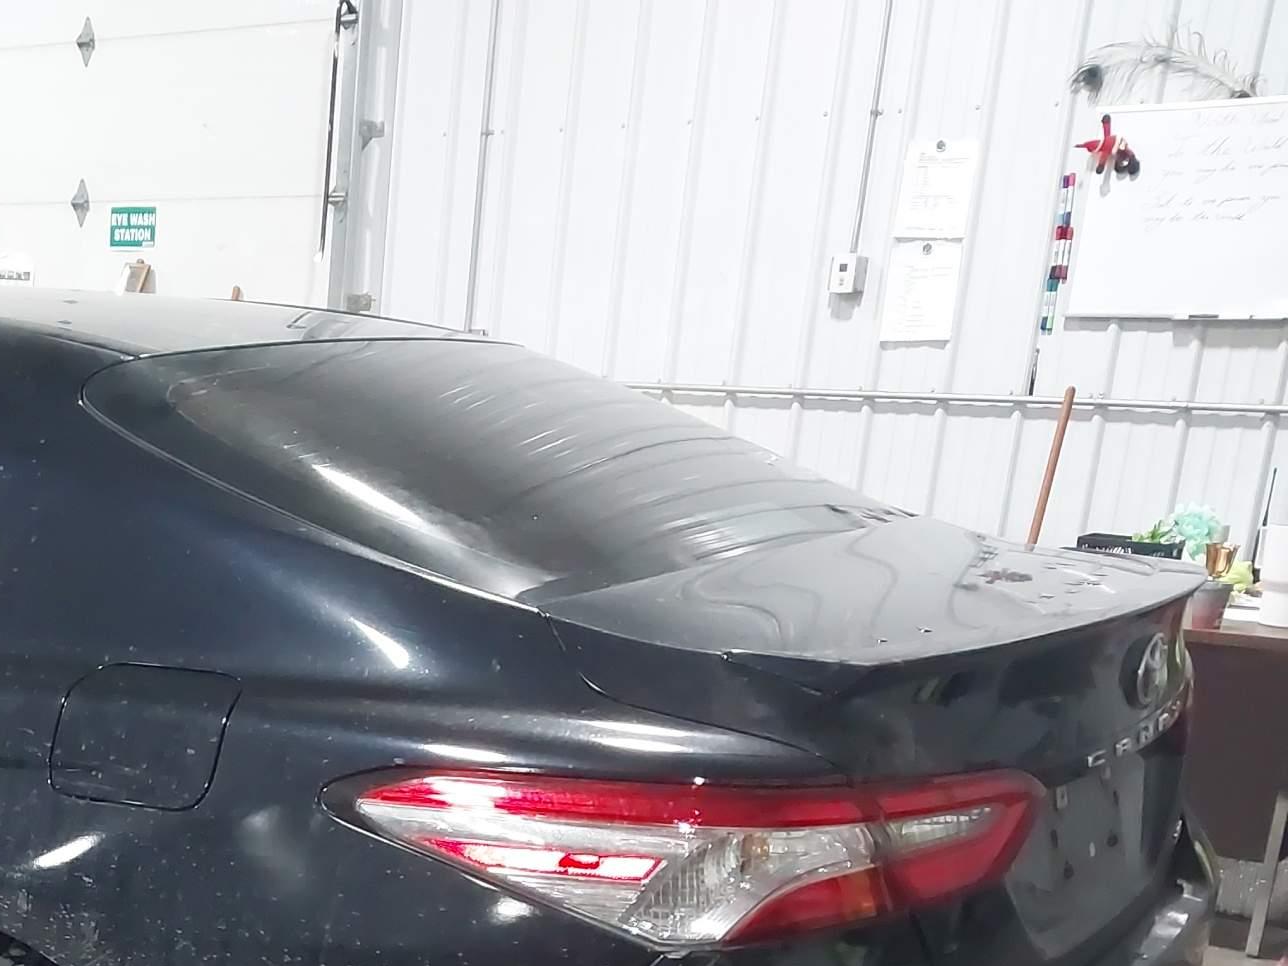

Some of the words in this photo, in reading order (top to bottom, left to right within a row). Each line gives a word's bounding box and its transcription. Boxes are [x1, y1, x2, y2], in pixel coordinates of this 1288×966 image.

[111, 212, 129, 226] EYE
[130, 212, 156, 226] WASH
[114, 228, 151, 242] STATION
